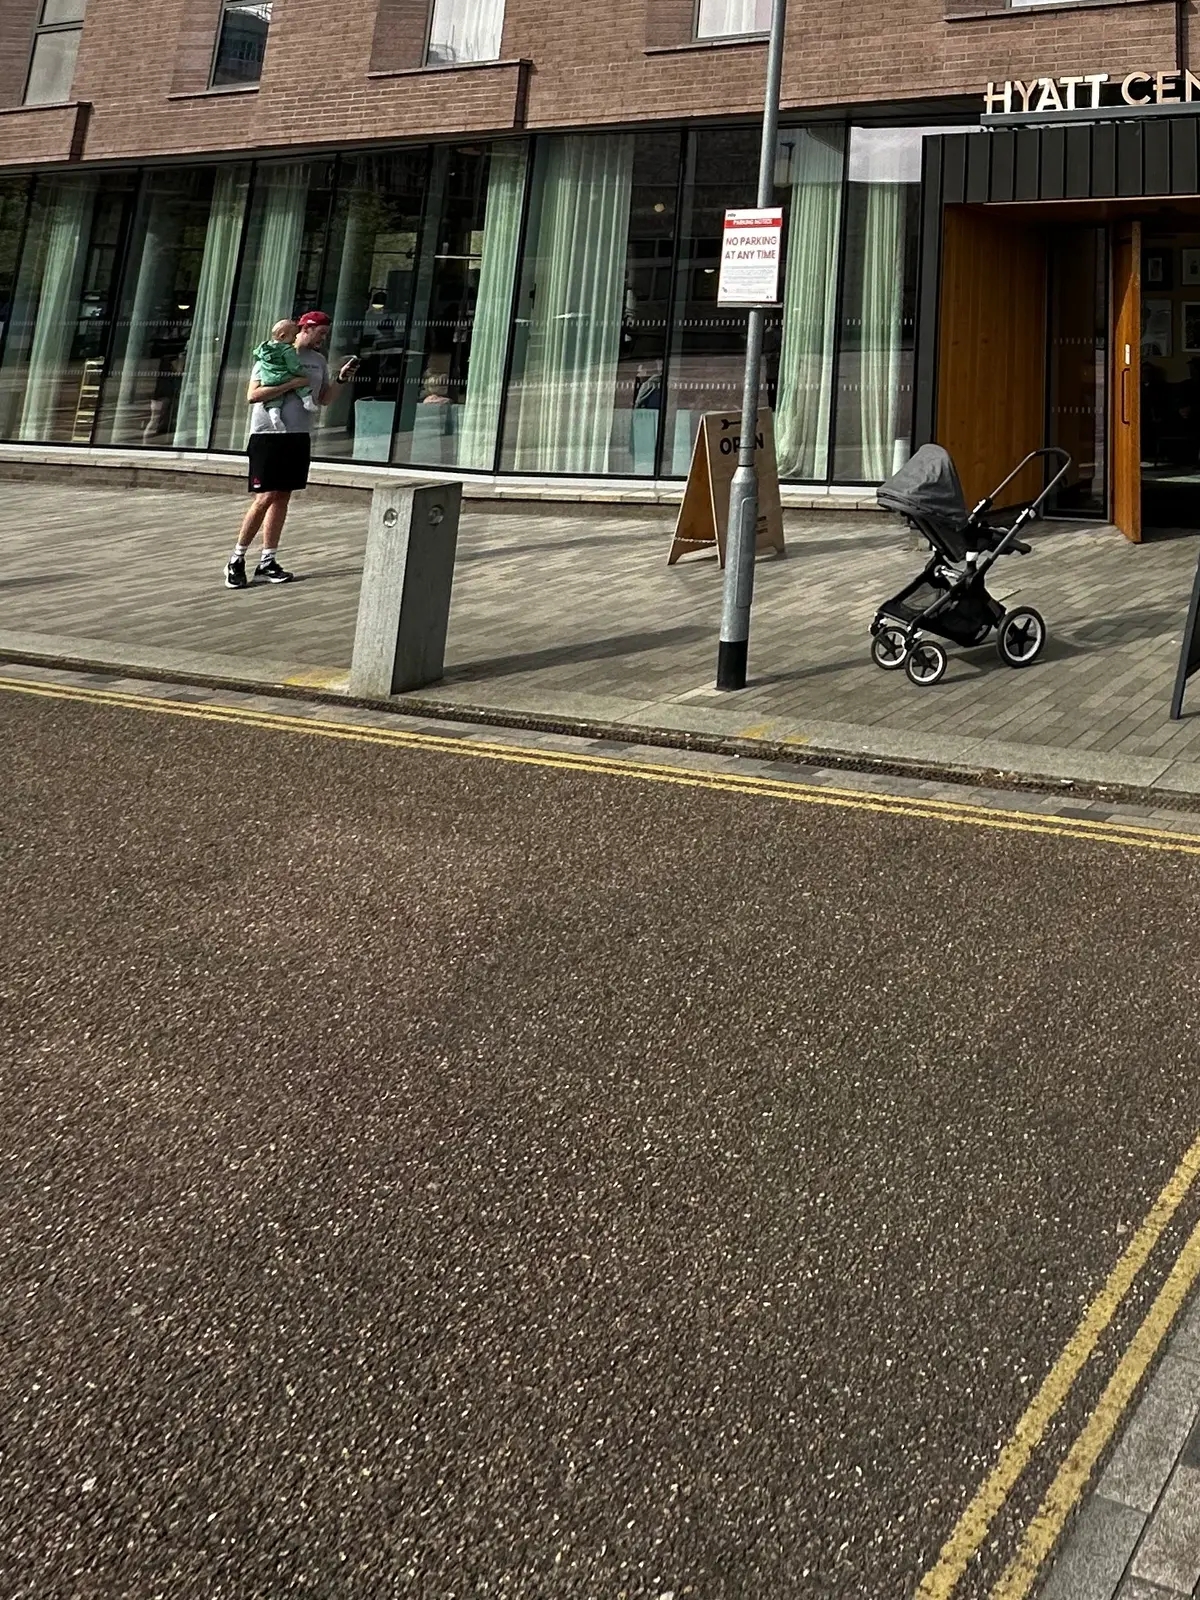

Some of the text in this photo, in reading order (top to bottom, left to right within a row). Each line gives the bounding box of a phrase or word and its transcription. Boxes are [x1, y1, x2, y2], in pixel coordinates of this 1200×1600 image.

[983, 73, 1109, 115] HYATT
[726, 236, 777, 246] NO PARKING
[725, 250, 776, 259] AT ANY TIME
[719, 432, 765, 455] OPN
